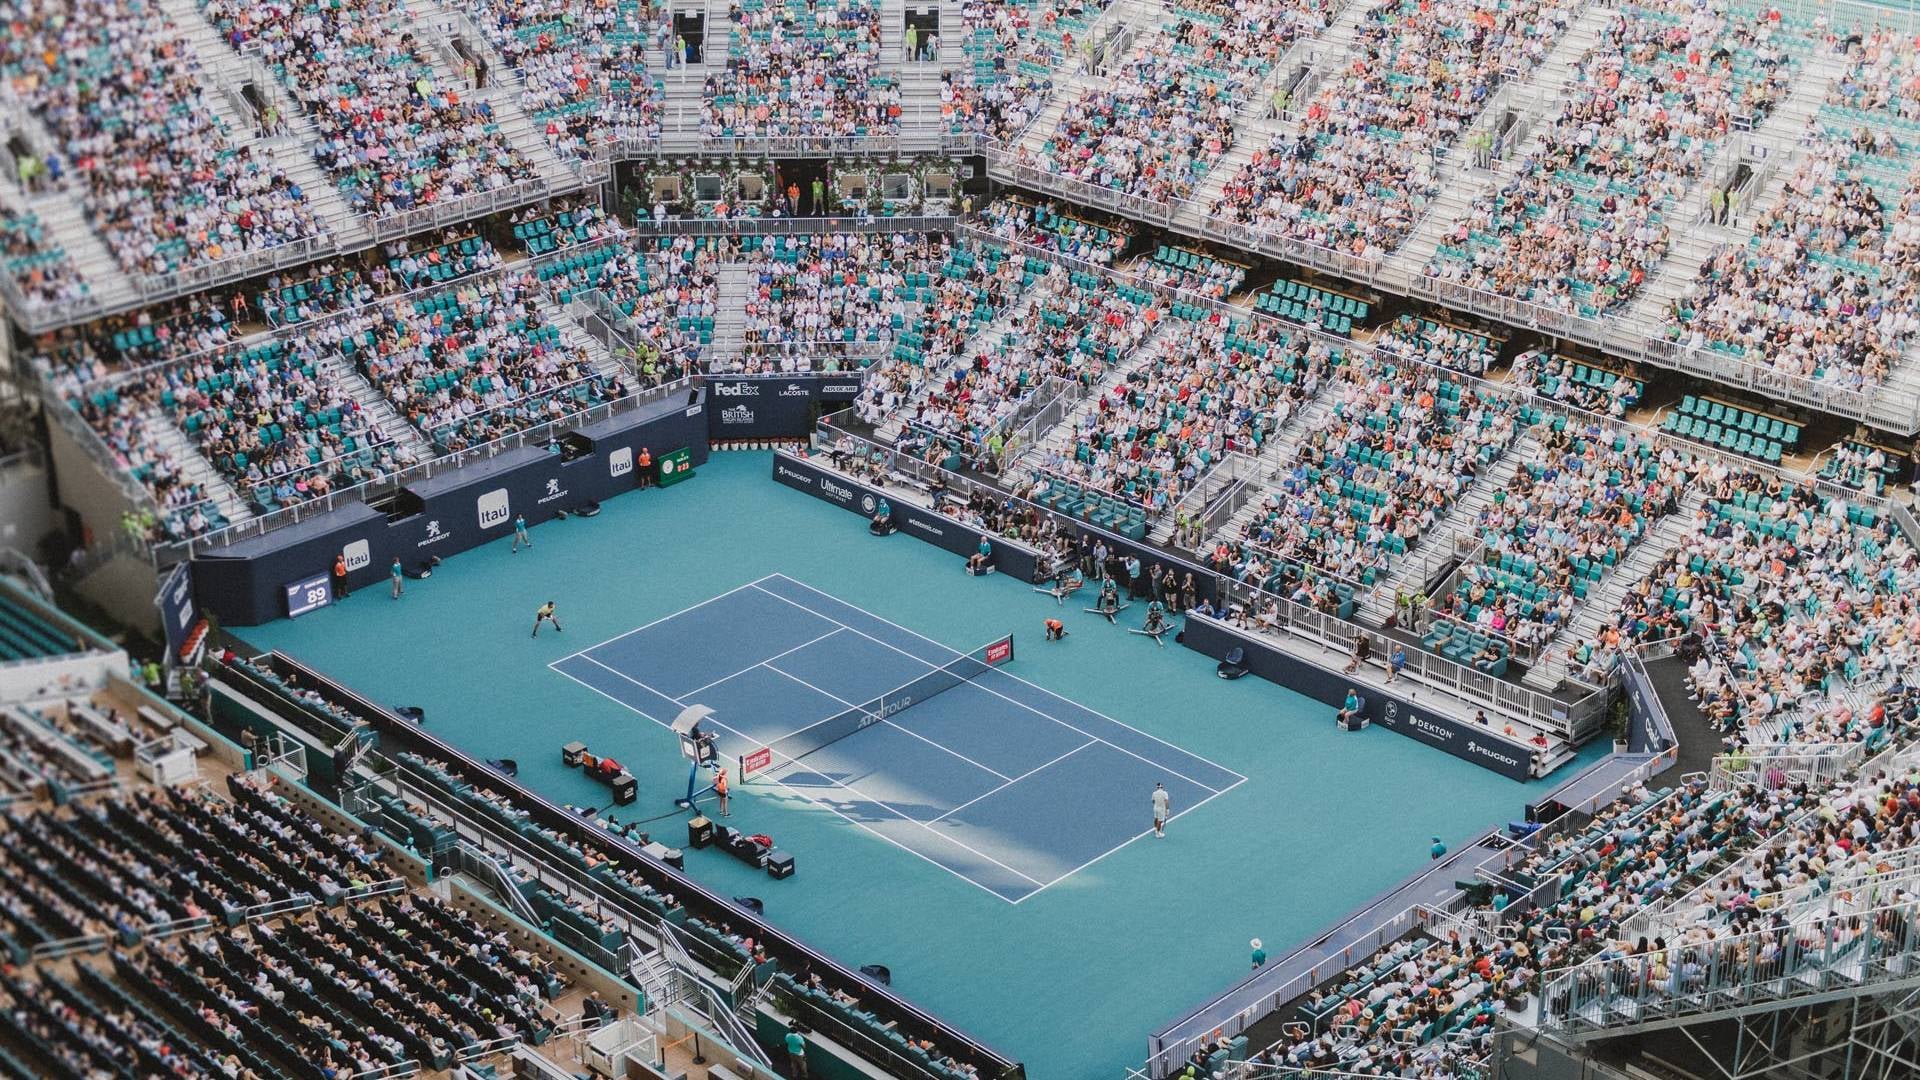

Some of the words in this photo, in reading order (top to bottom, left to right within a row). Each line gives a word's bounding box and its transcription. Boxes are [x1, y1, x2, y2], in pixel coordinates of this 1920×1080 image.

[715, 382, 760, 396] FedEx
[823, 385, 858, 393] ADVOCARE
[722, 410, 754, 419] BRITISH
[612, 460, 631, 473] Itaú
[784, 469, 812, 484] PEUGEOT
[537, 490, 569, 504] PEUGEOT
[820, 478, 853, 500] Ultimate
[481, 504, 507, 524] Itaú
[417, 531, 450, 548] PEUGEOT
[346, 552, 368, 568] Itaú
[307, 587, 326, 603] 89
[883, 696, 911, 717] TOUR
[1417, 719, 1452, 739] DEKTON
[1476, 745, 1518, 767] PEUGEOT
